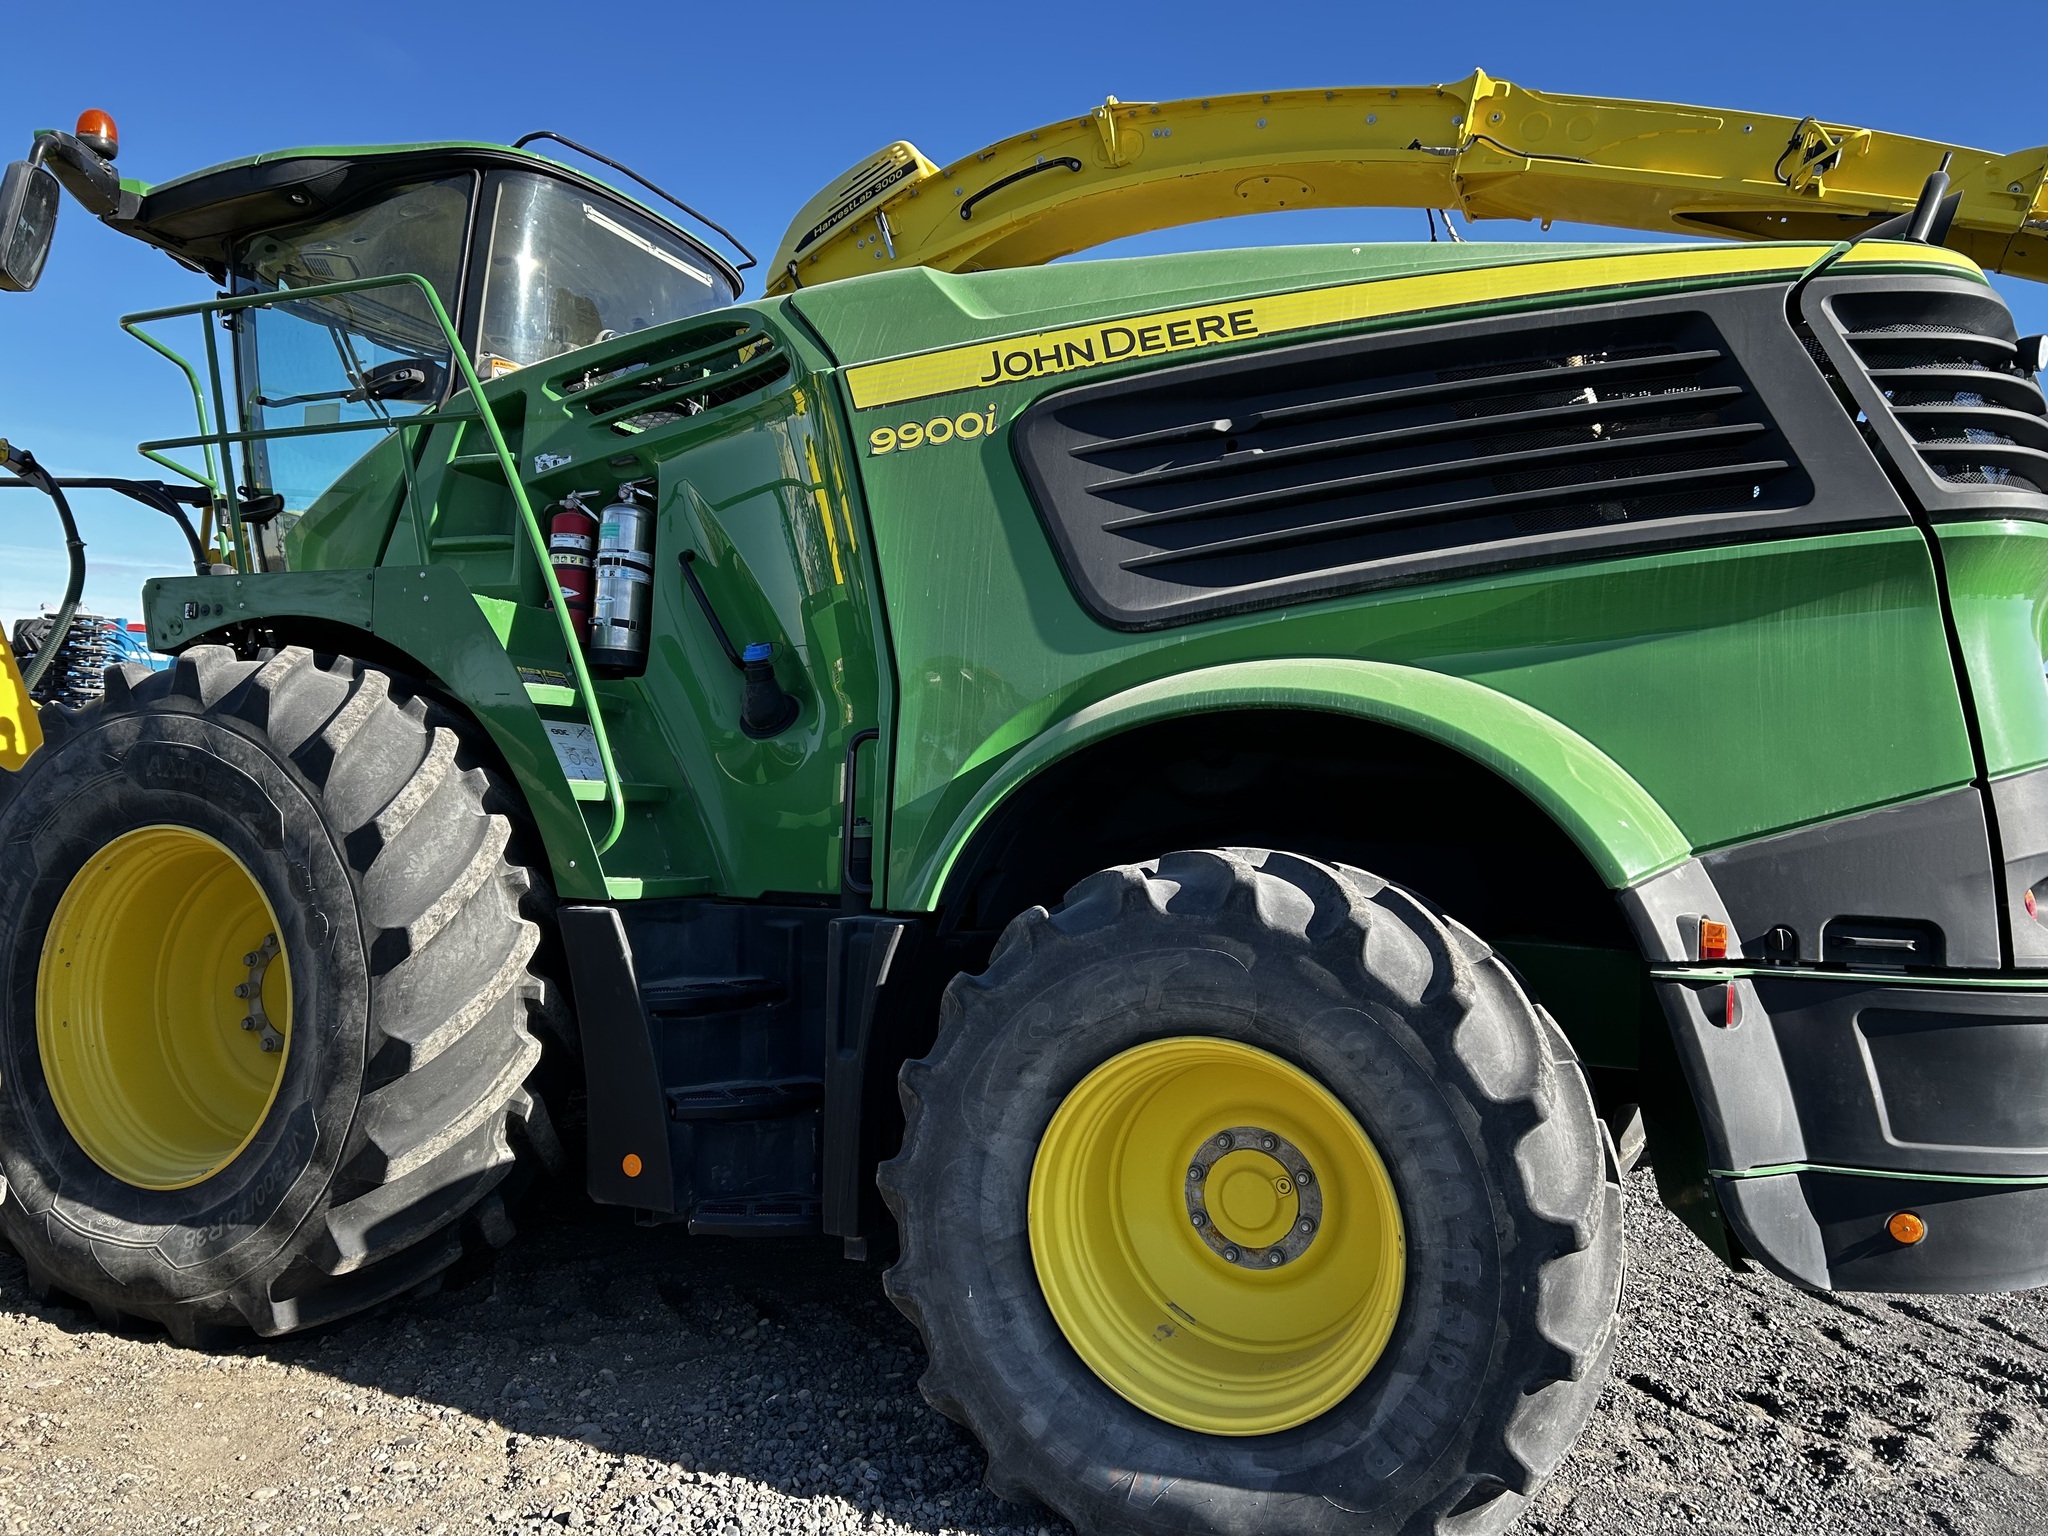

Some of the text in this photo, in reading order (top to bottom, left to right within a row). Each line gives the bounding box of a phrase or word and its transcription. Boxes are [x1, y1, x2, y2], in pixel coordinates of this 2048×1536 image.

[813, 168, 904, 238] HarvestLab 3000
[980, 308, 1260, 385] JOHN DEERE
[868, 403, 999, 455] 9900i
